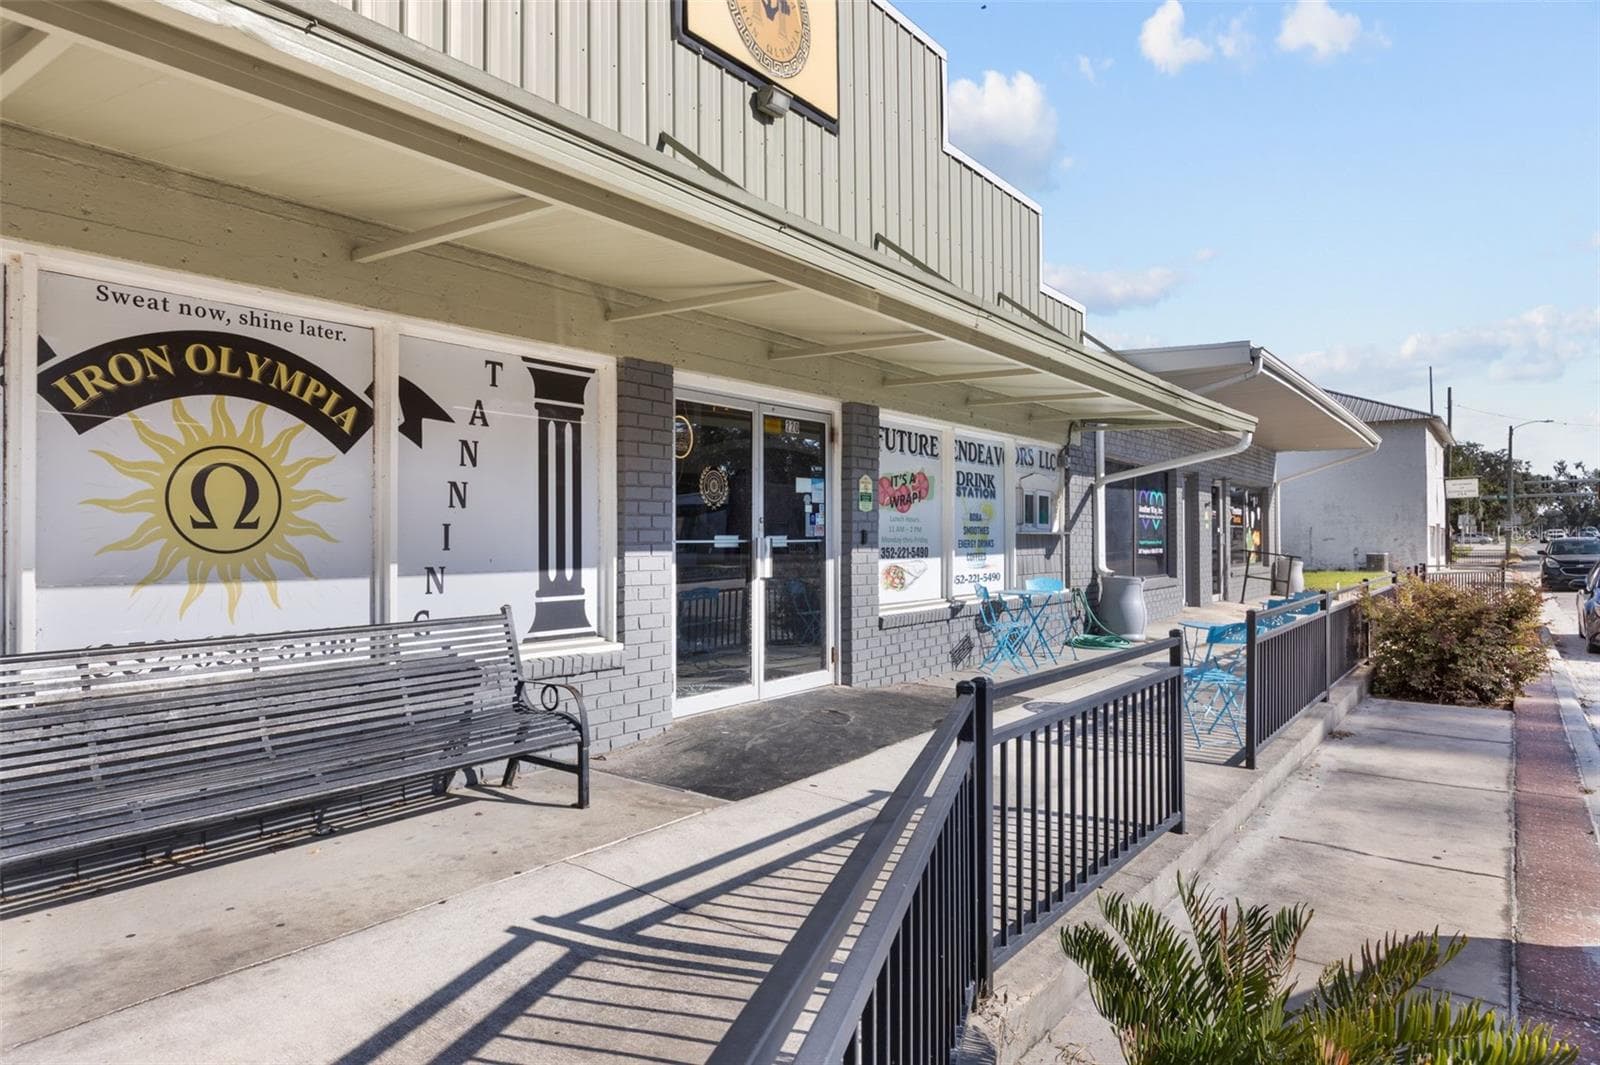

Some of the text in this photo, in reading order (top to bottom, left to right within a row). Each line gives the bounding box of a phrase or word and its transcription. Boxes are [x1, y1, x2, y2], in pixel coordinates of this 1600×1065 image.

[96, 284, 347, 342] Sweat now, shine later.
[51, 343, 359, 436] IRON OLYMPIA
[1039, 449, 1057, 471] LLC
[890, 472, 917, 488] IT'S A
[956, 470, 996, 490] DRINK
[889, 490, 921, 509] WRAP!
[955, 486, 996, 500] STATION
[880, 546, 929, 559] 352-221-5490
[953, 571, 1002, 586] 52-221-5490
